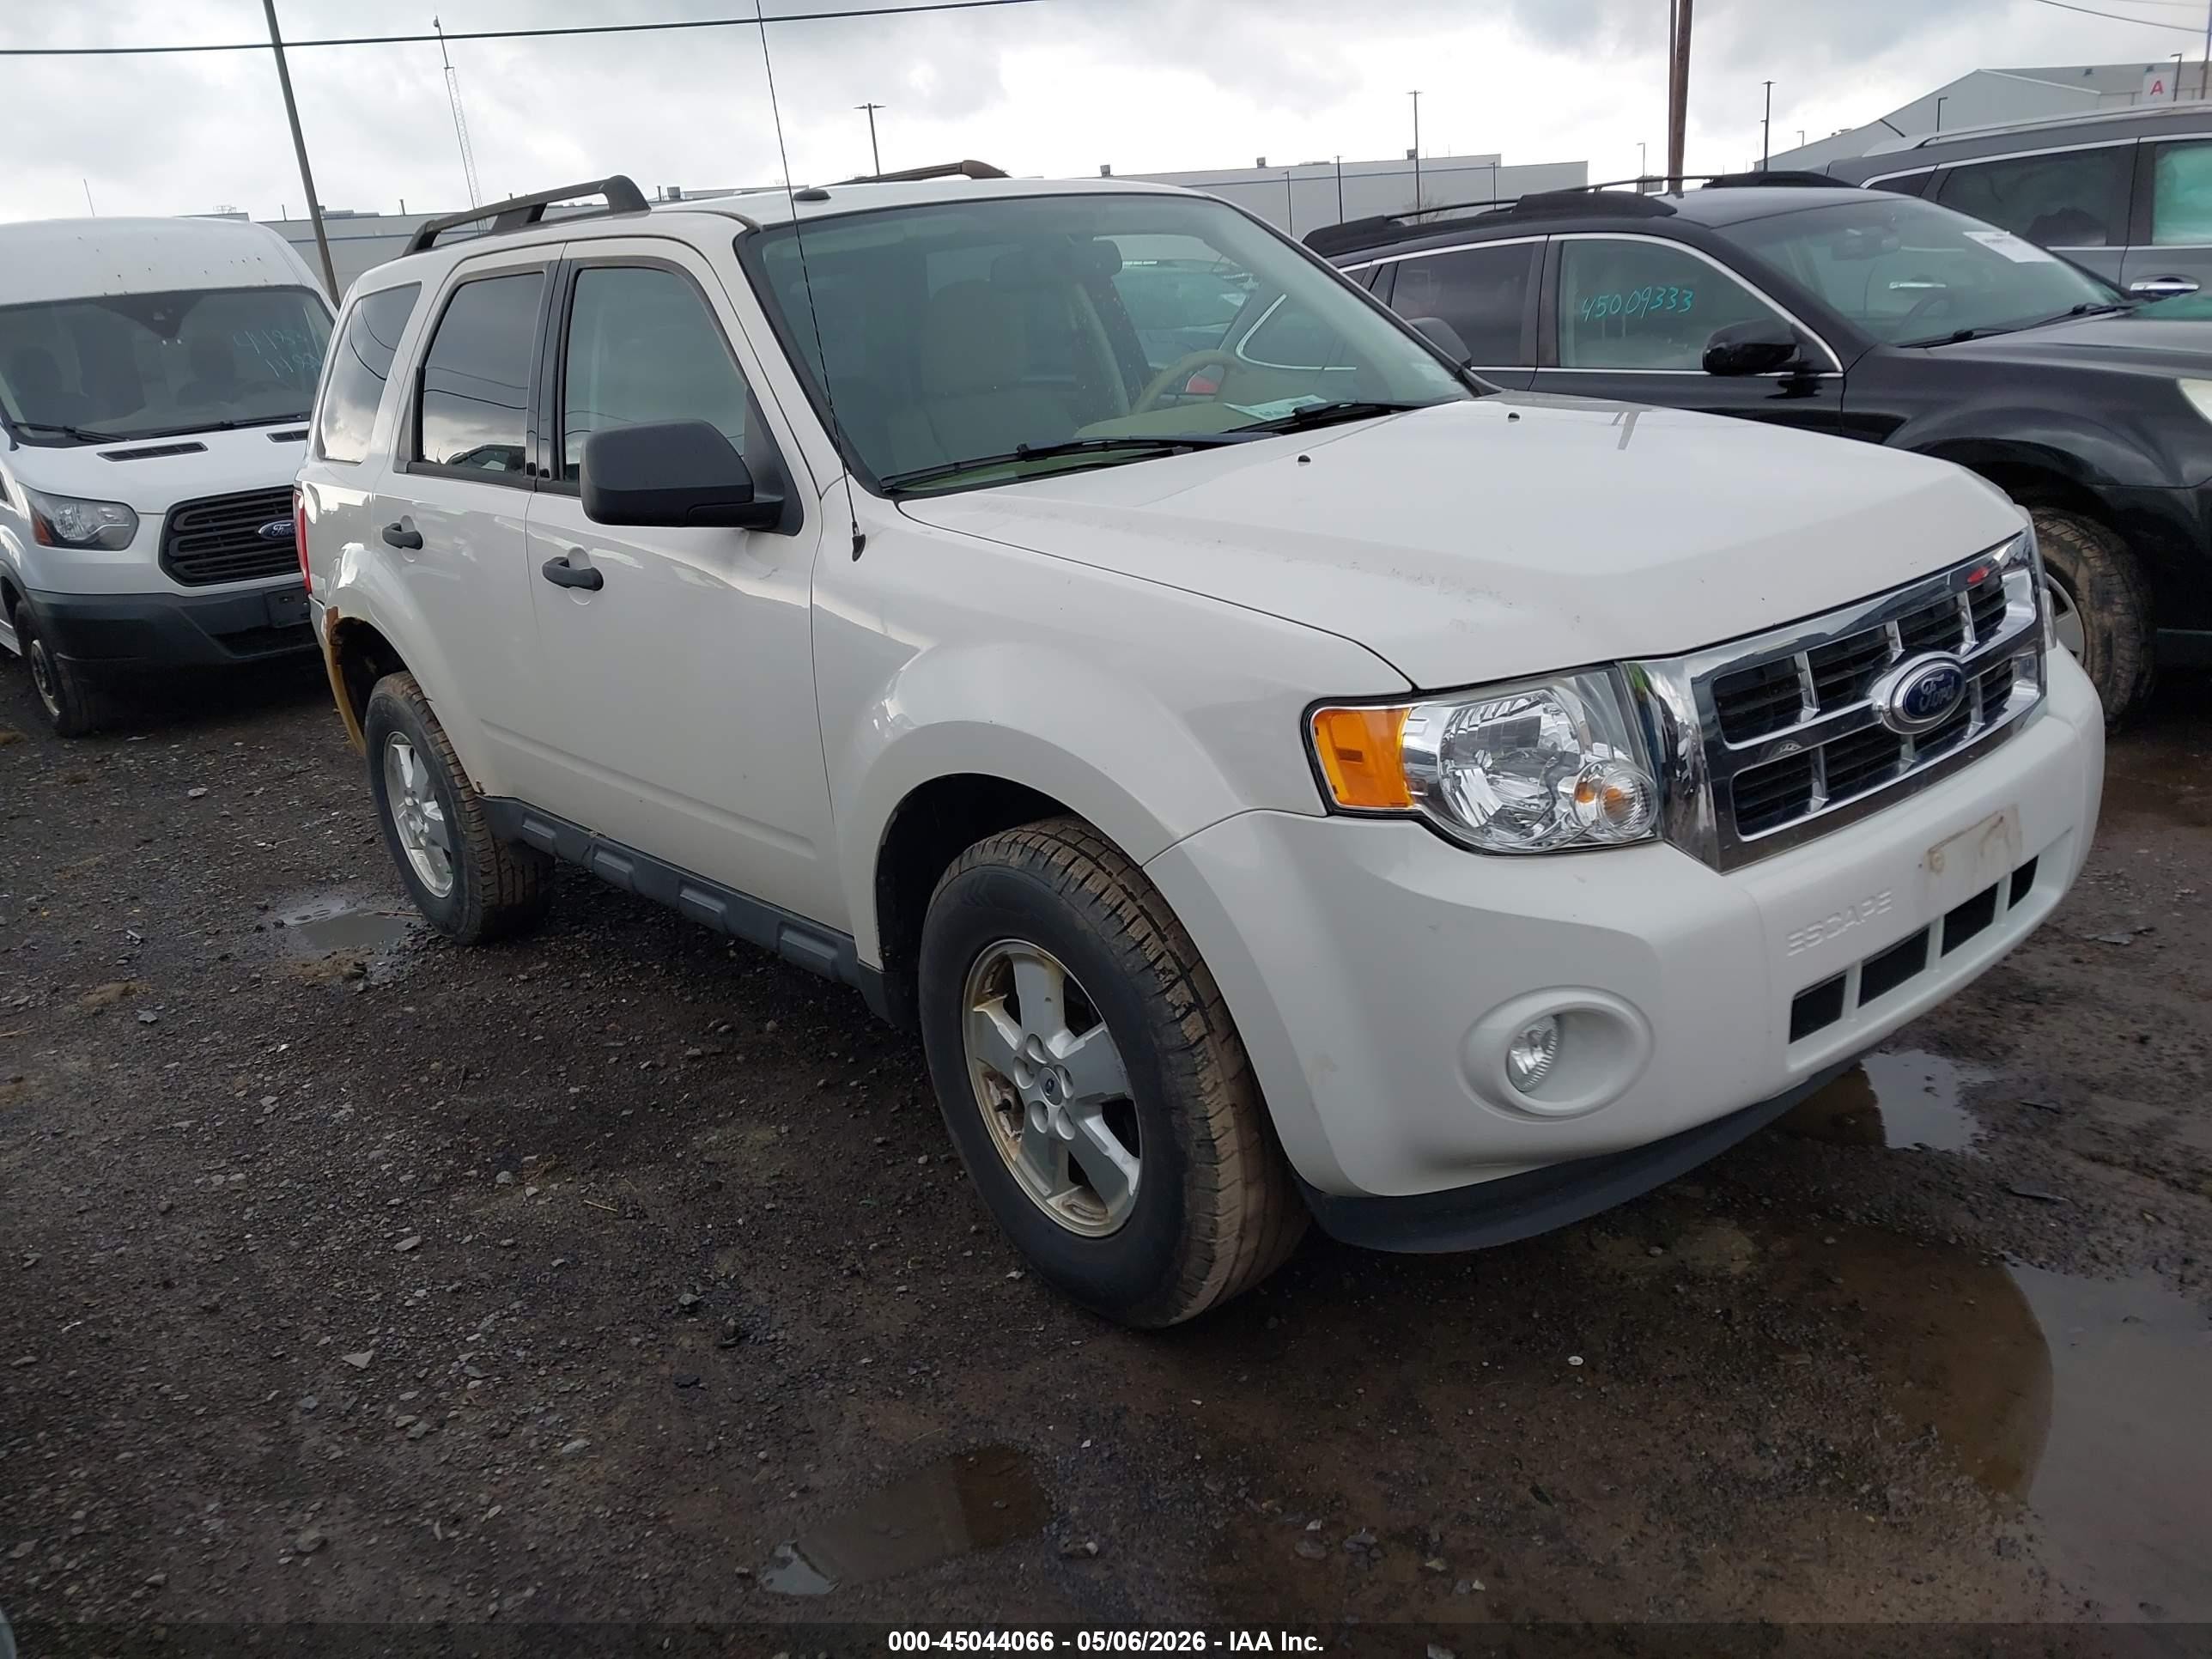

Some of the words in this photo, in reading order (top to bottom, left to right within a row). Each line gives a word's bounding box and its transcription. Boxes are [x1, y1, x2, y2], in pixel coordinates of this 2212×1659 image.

[2149, 80, 2164, 95] A
[1582, 286, 1694, 322] 45009333
[1919, 673, 1955, 712] Ford
[1787, 889, 1893, 957] ESCAPE
